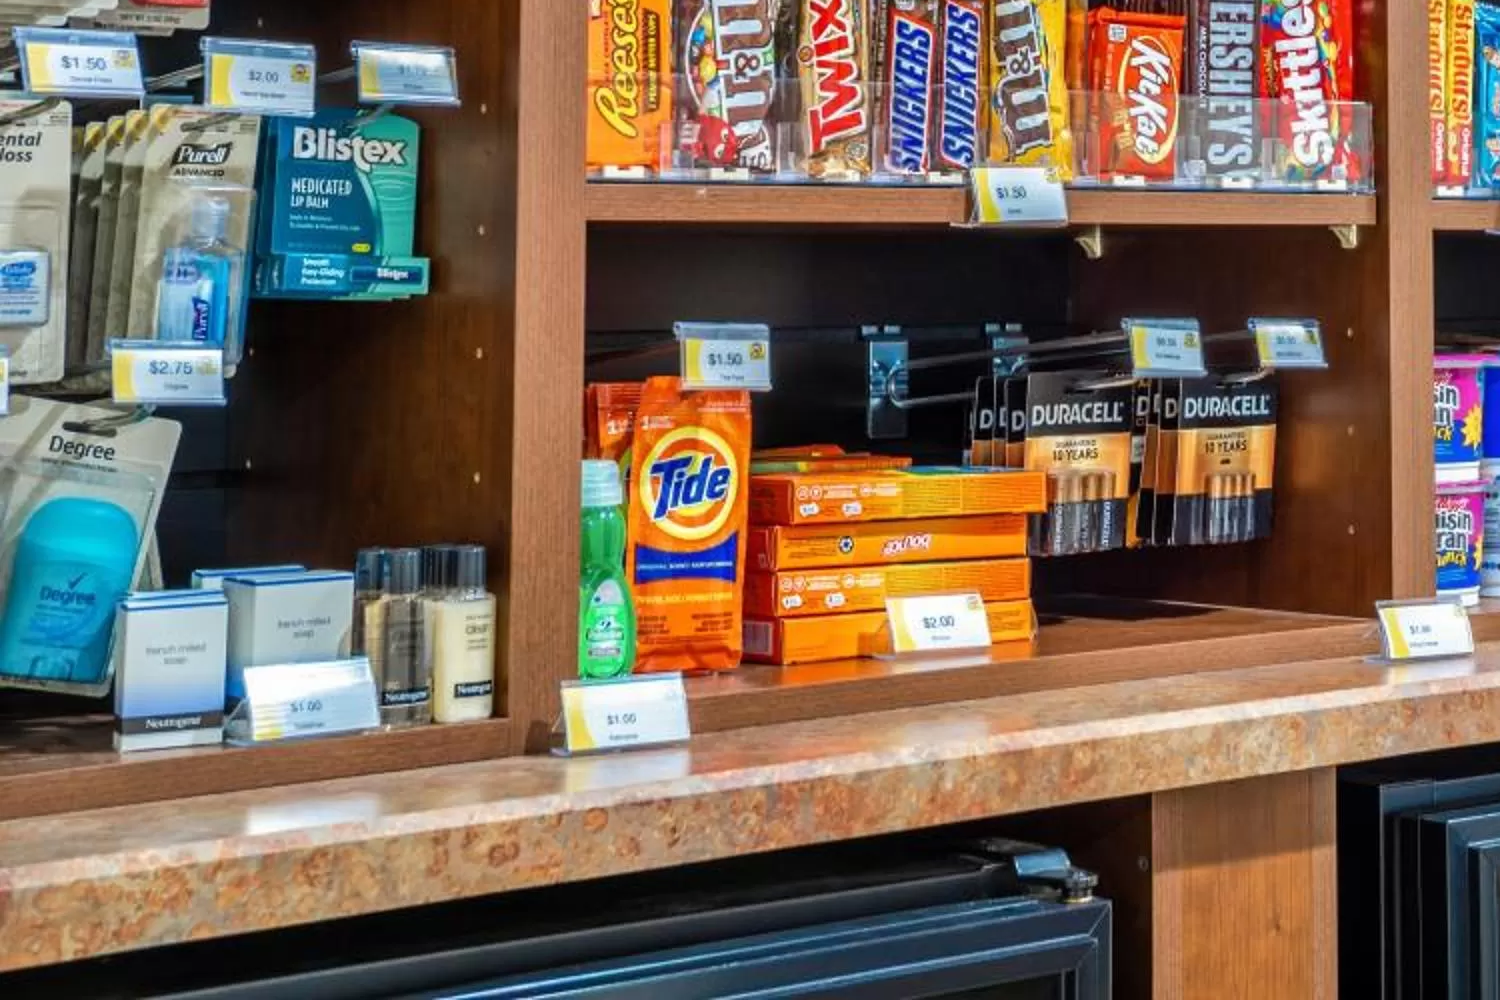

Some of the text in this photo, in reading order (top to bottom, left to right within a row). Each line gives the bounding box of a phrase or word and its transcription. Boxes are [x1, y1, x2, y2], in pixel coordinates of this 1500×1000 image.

[942, 0, 981, 167] SNICKERS
[890, 17, 933, 174] SNICKERS
[0, 131, 42, 148] ental
[293, 126, 406, 173] Blistex
[0, 147, 33, 163] loss
[178, 144, 228, 165] Purell
[291, 177, 352, 196] MEDICATED
[290, 195, 329, 209] LIP BALM
[150, 360, 193, 376] $2.75
[707, 352, 743, 367] $1.50
[1031, 401, 1125, 425] DURACELL
[1184, 395, 1271, 418] DURACELL
[49, 435, 115, 461] Degree
[1064, 448, 1099, 461] YEARS
[1218, 439, 1248, 453] YEARS
[650, 454, 731, 522] Tide
[1435, 509, 1473, 532] aisin
[1435, 530, 1469, 552] ran
[39, 585, 95, 607] Degree
[923, 616, 955, 629] $2.00
